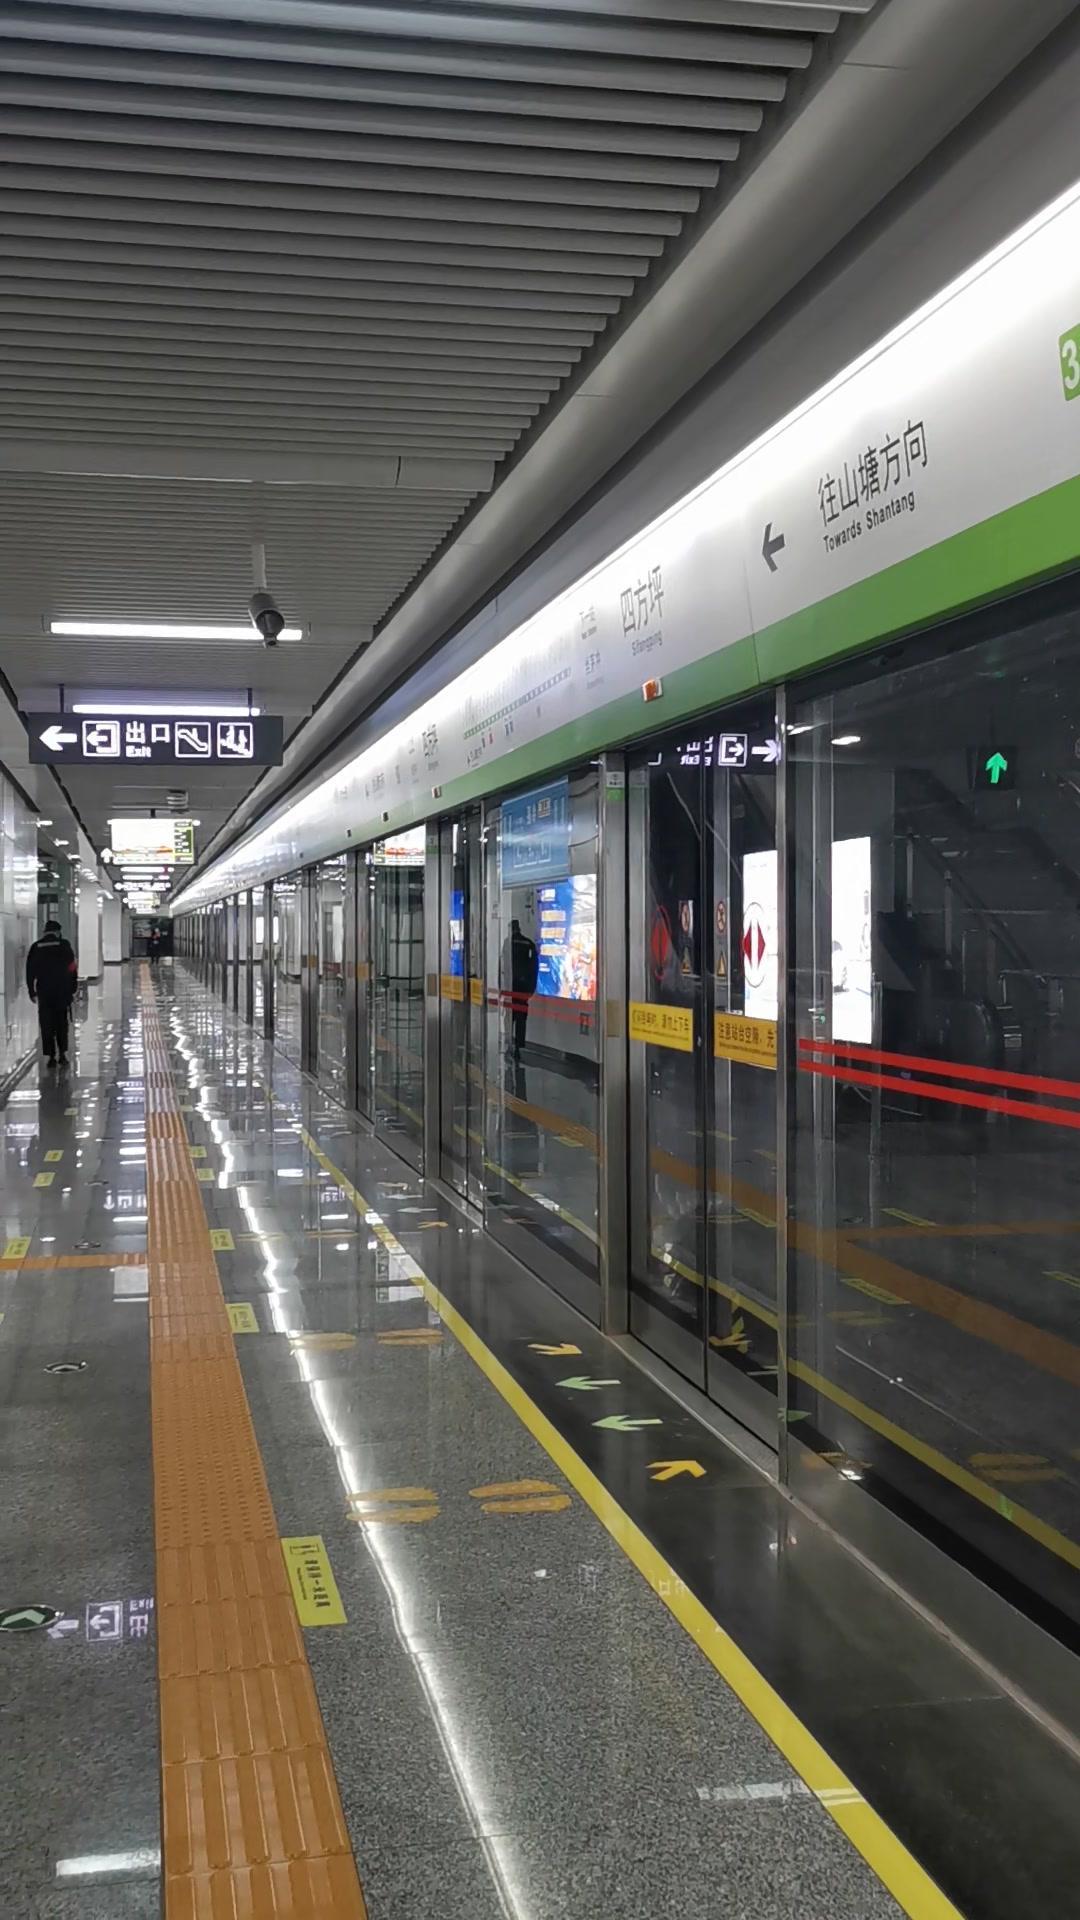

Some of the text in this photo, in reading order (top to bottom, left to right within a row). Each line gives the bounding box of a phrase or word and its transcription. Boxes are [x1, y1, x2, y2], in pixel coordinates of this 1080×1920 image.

[1062, 339, 1080, 390] 3
[817, 419, 928, 527] 往山塘方向
[823, 490, 915, 553] Towards Shantang
[620, 565, 664, 637] 四方坪
[126, 721, 170, 744] 出口
[126, 745, 151, 758] Exit
